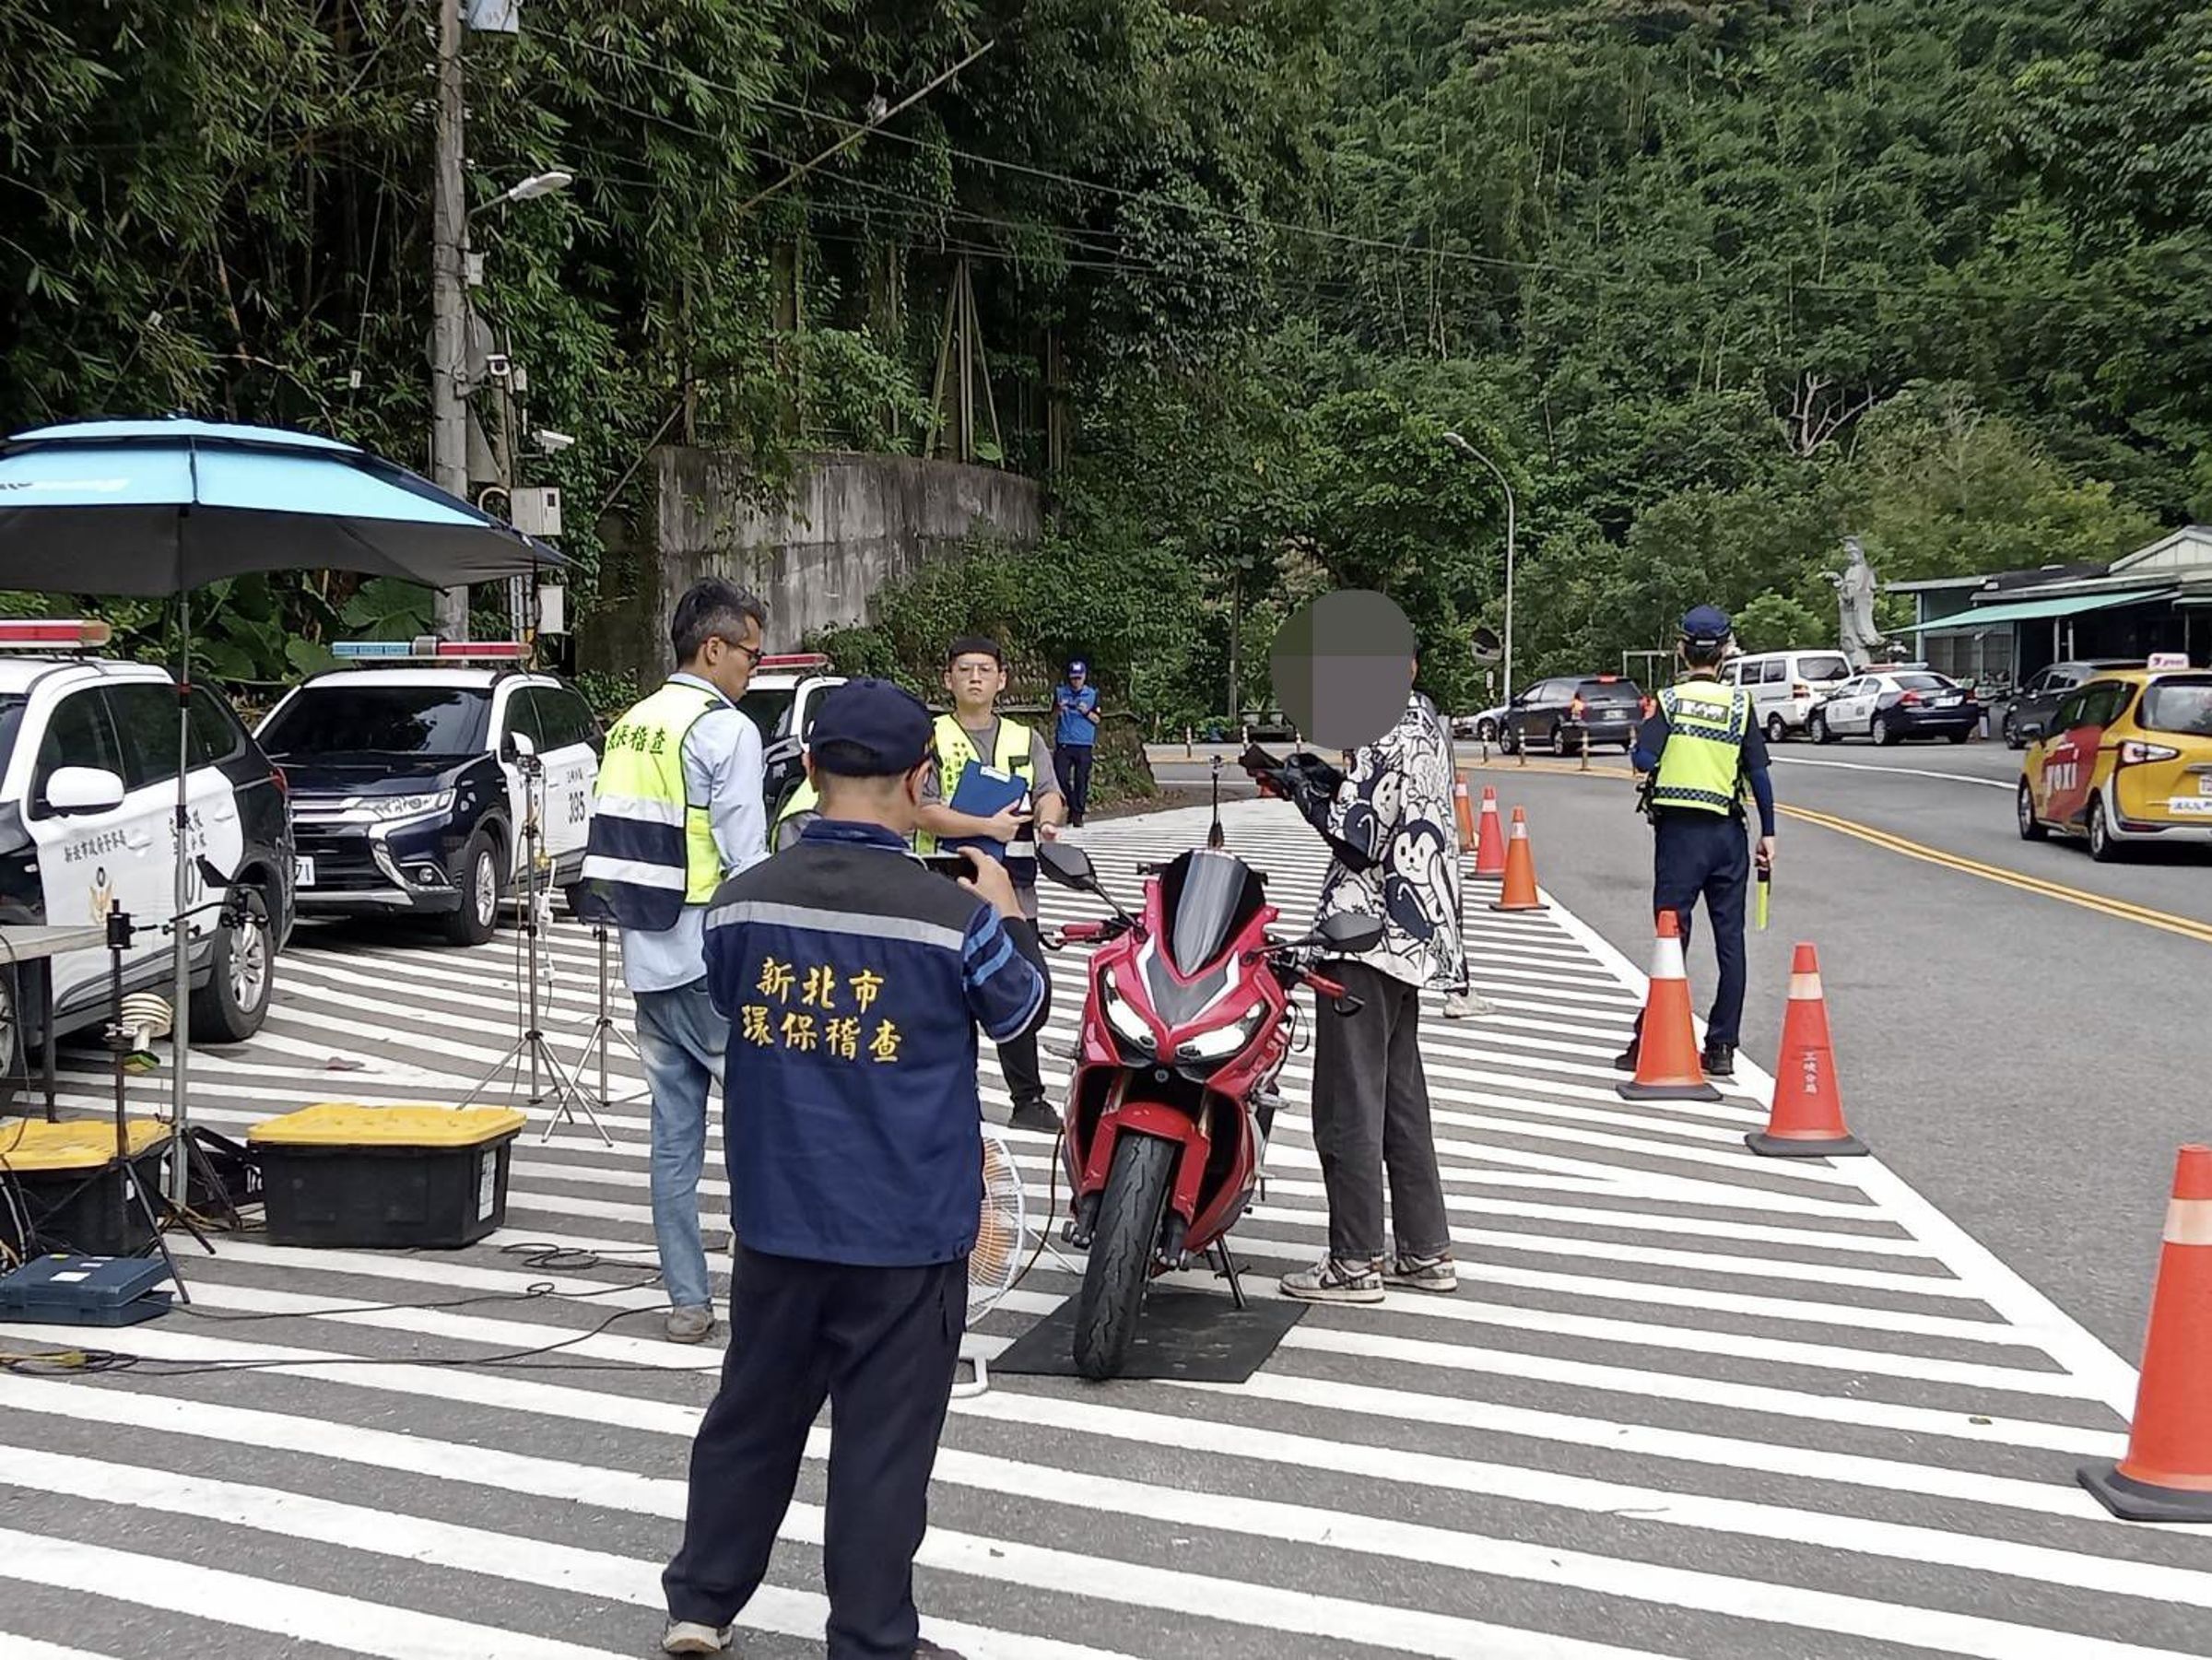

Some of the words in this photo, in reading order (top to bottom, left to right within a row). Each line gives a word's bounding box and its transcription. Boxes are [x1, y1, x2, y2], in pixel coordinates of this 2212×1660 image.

[569, 790, 585, 825] 395
[756, 956, 884, 1015] 新北市
[741, 1004, 902, 1063] 環保稽查
